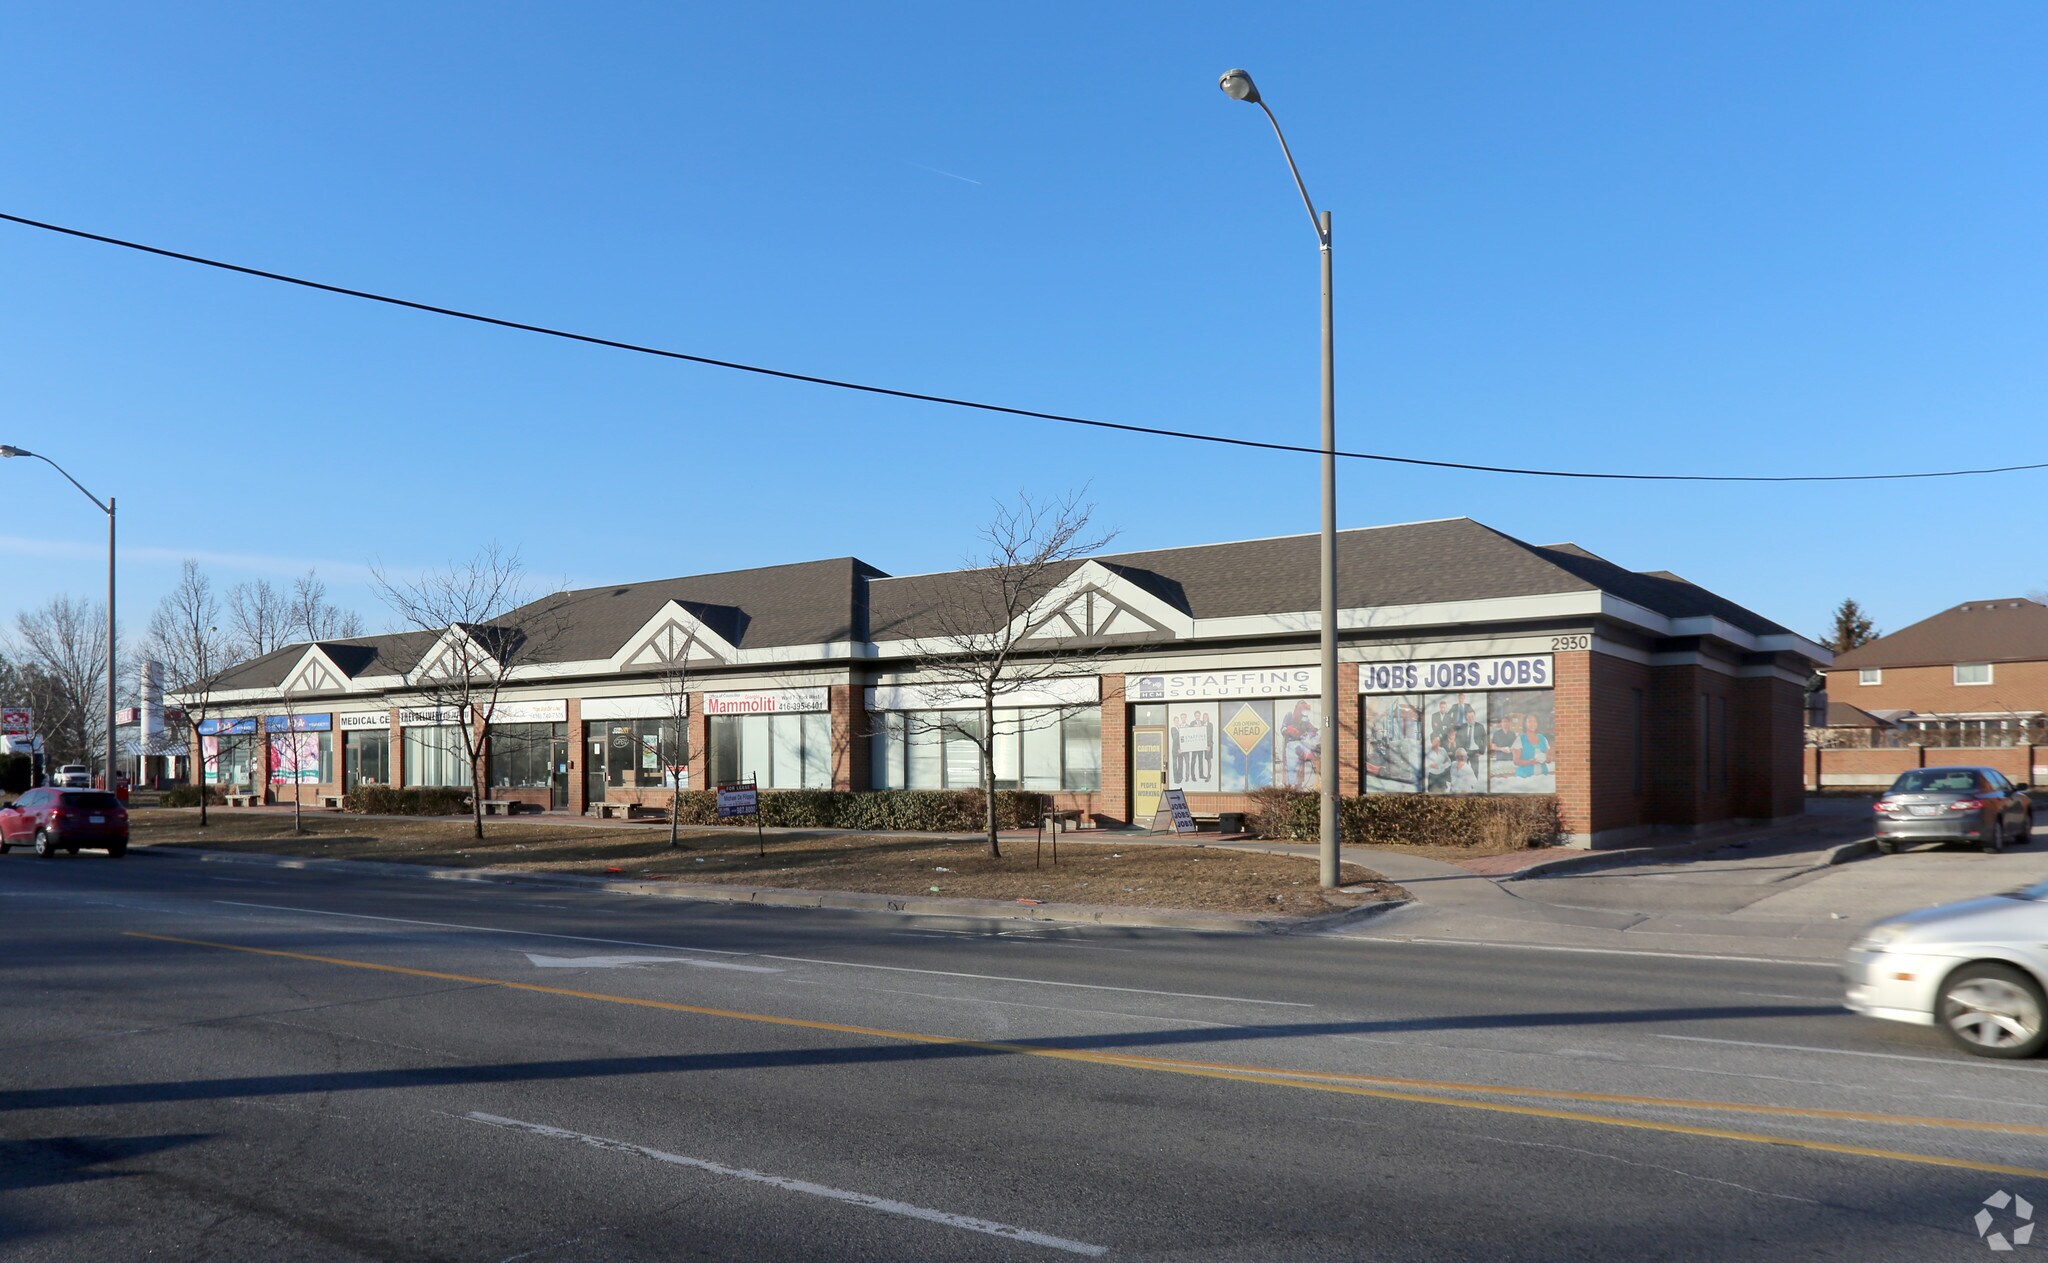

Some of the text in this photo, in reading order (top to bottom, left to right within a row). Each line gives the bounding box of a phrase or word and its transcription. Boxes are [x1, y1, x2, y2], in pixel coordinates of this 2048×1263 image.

[1551, 636, 1588, 650] 2930
[1170, 671, 1310, 687] STAFFING
[1364, 659, 1546, 689] JOBS JOBS JOBS
[1170, 684, 1309, 696] SOLUTIONS
[708, 697, 775, 713] Mammoliti
[341, 716, 377, 725] MEDICAL
[1233, 727, 1260, 736] AHEAD
[1174, 811, 1190, 819] JOBS
[1177, 820, 1193, 828] JOBS
